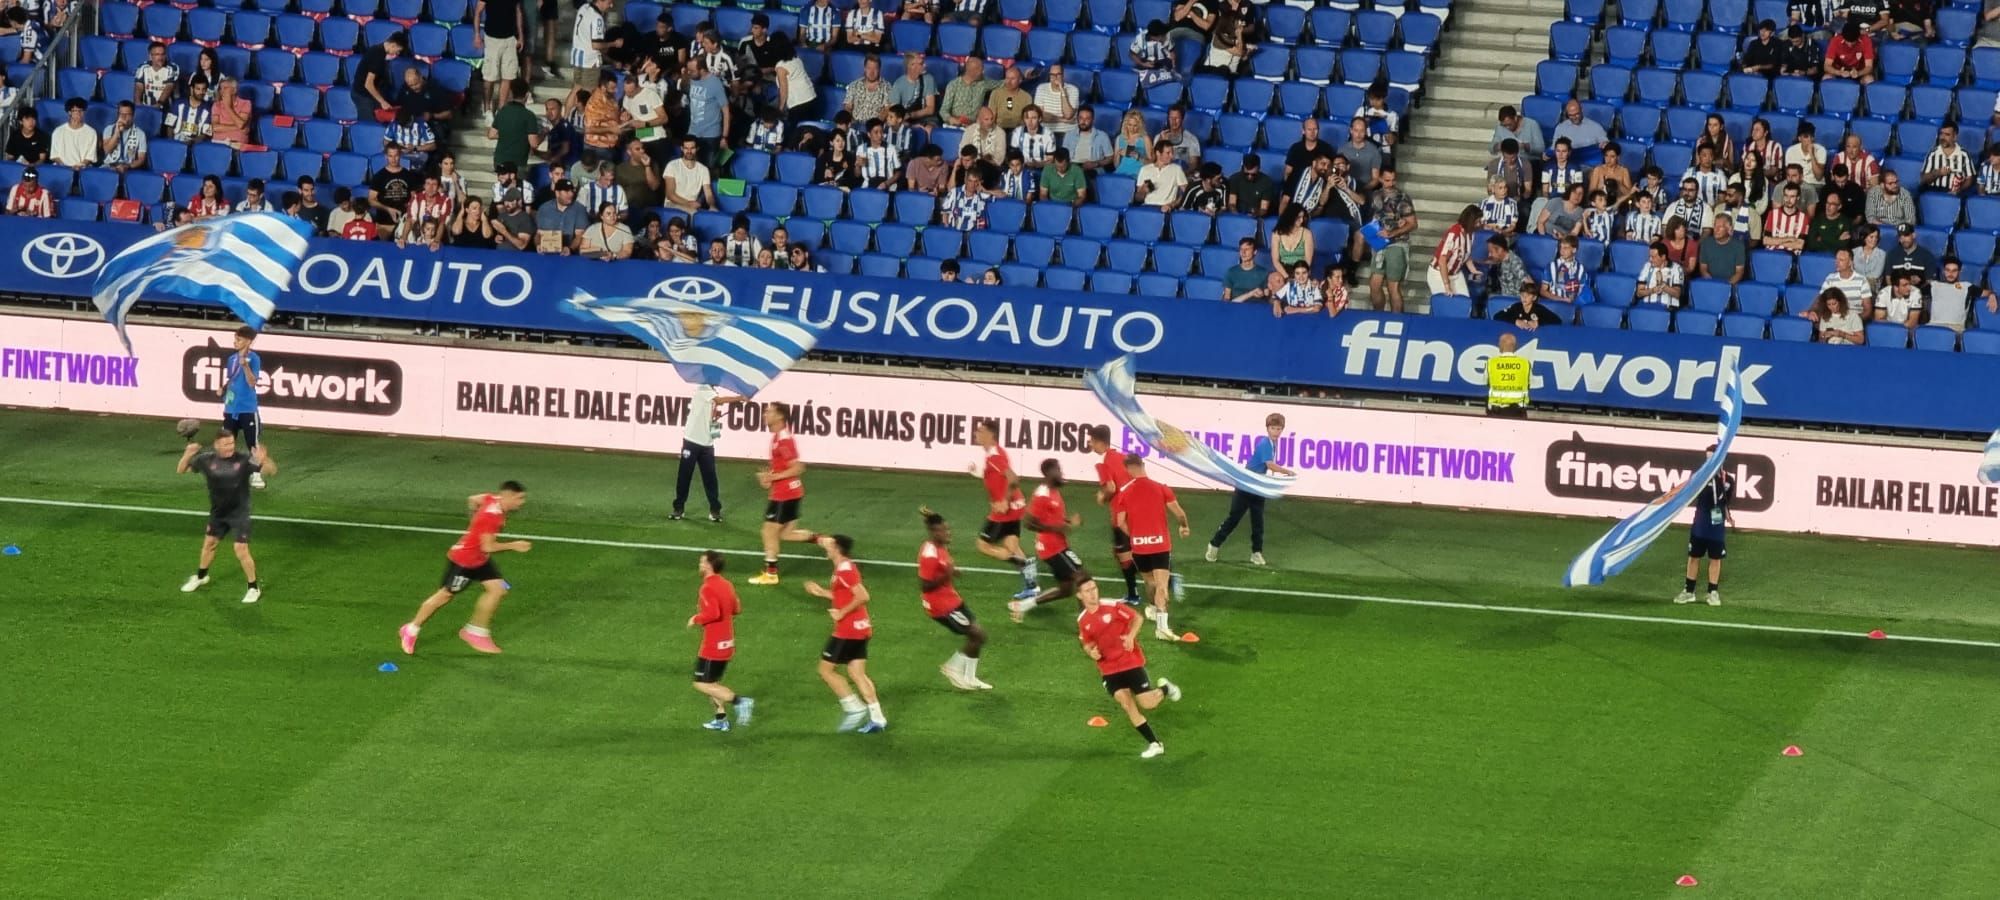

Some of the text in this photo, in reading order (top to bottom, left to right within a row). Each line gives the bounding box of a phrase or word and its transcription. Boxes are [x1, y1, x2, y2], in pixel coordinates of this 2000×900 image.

[1850, 4, 1877, 13] CAZOO
[279, 253, 533, 307] OAUTO
[2, 348, 140, 387] FINETWORK
[1341, 320, 1774, 405] finetwork
[1496, 362, 1521, 370] SABICO
[1500, 373, 1516, 382] 236
[456, 381, 541, 415] BAILAR
[544, 387, 570, 418] EL
[574, 389, 631, 423] DALE
[785, 399, 832, 436] MÁS
[836, 407, 914, 442] GANAS
[920, 413, 966, 448] QUE
[1005, 418, 1032, 449] LA
[1238, 432, 1296, 467] AUÍ
[1300, 438, 1368, 472] COMO
[1373, 445, 1516, 483] FINETWORK
[1556, 451, 1763, 501] finetwk
[1817, 475, 1999, 517] BAILAR EL DALE
[1133, 535, 1163, 545] DIGI
